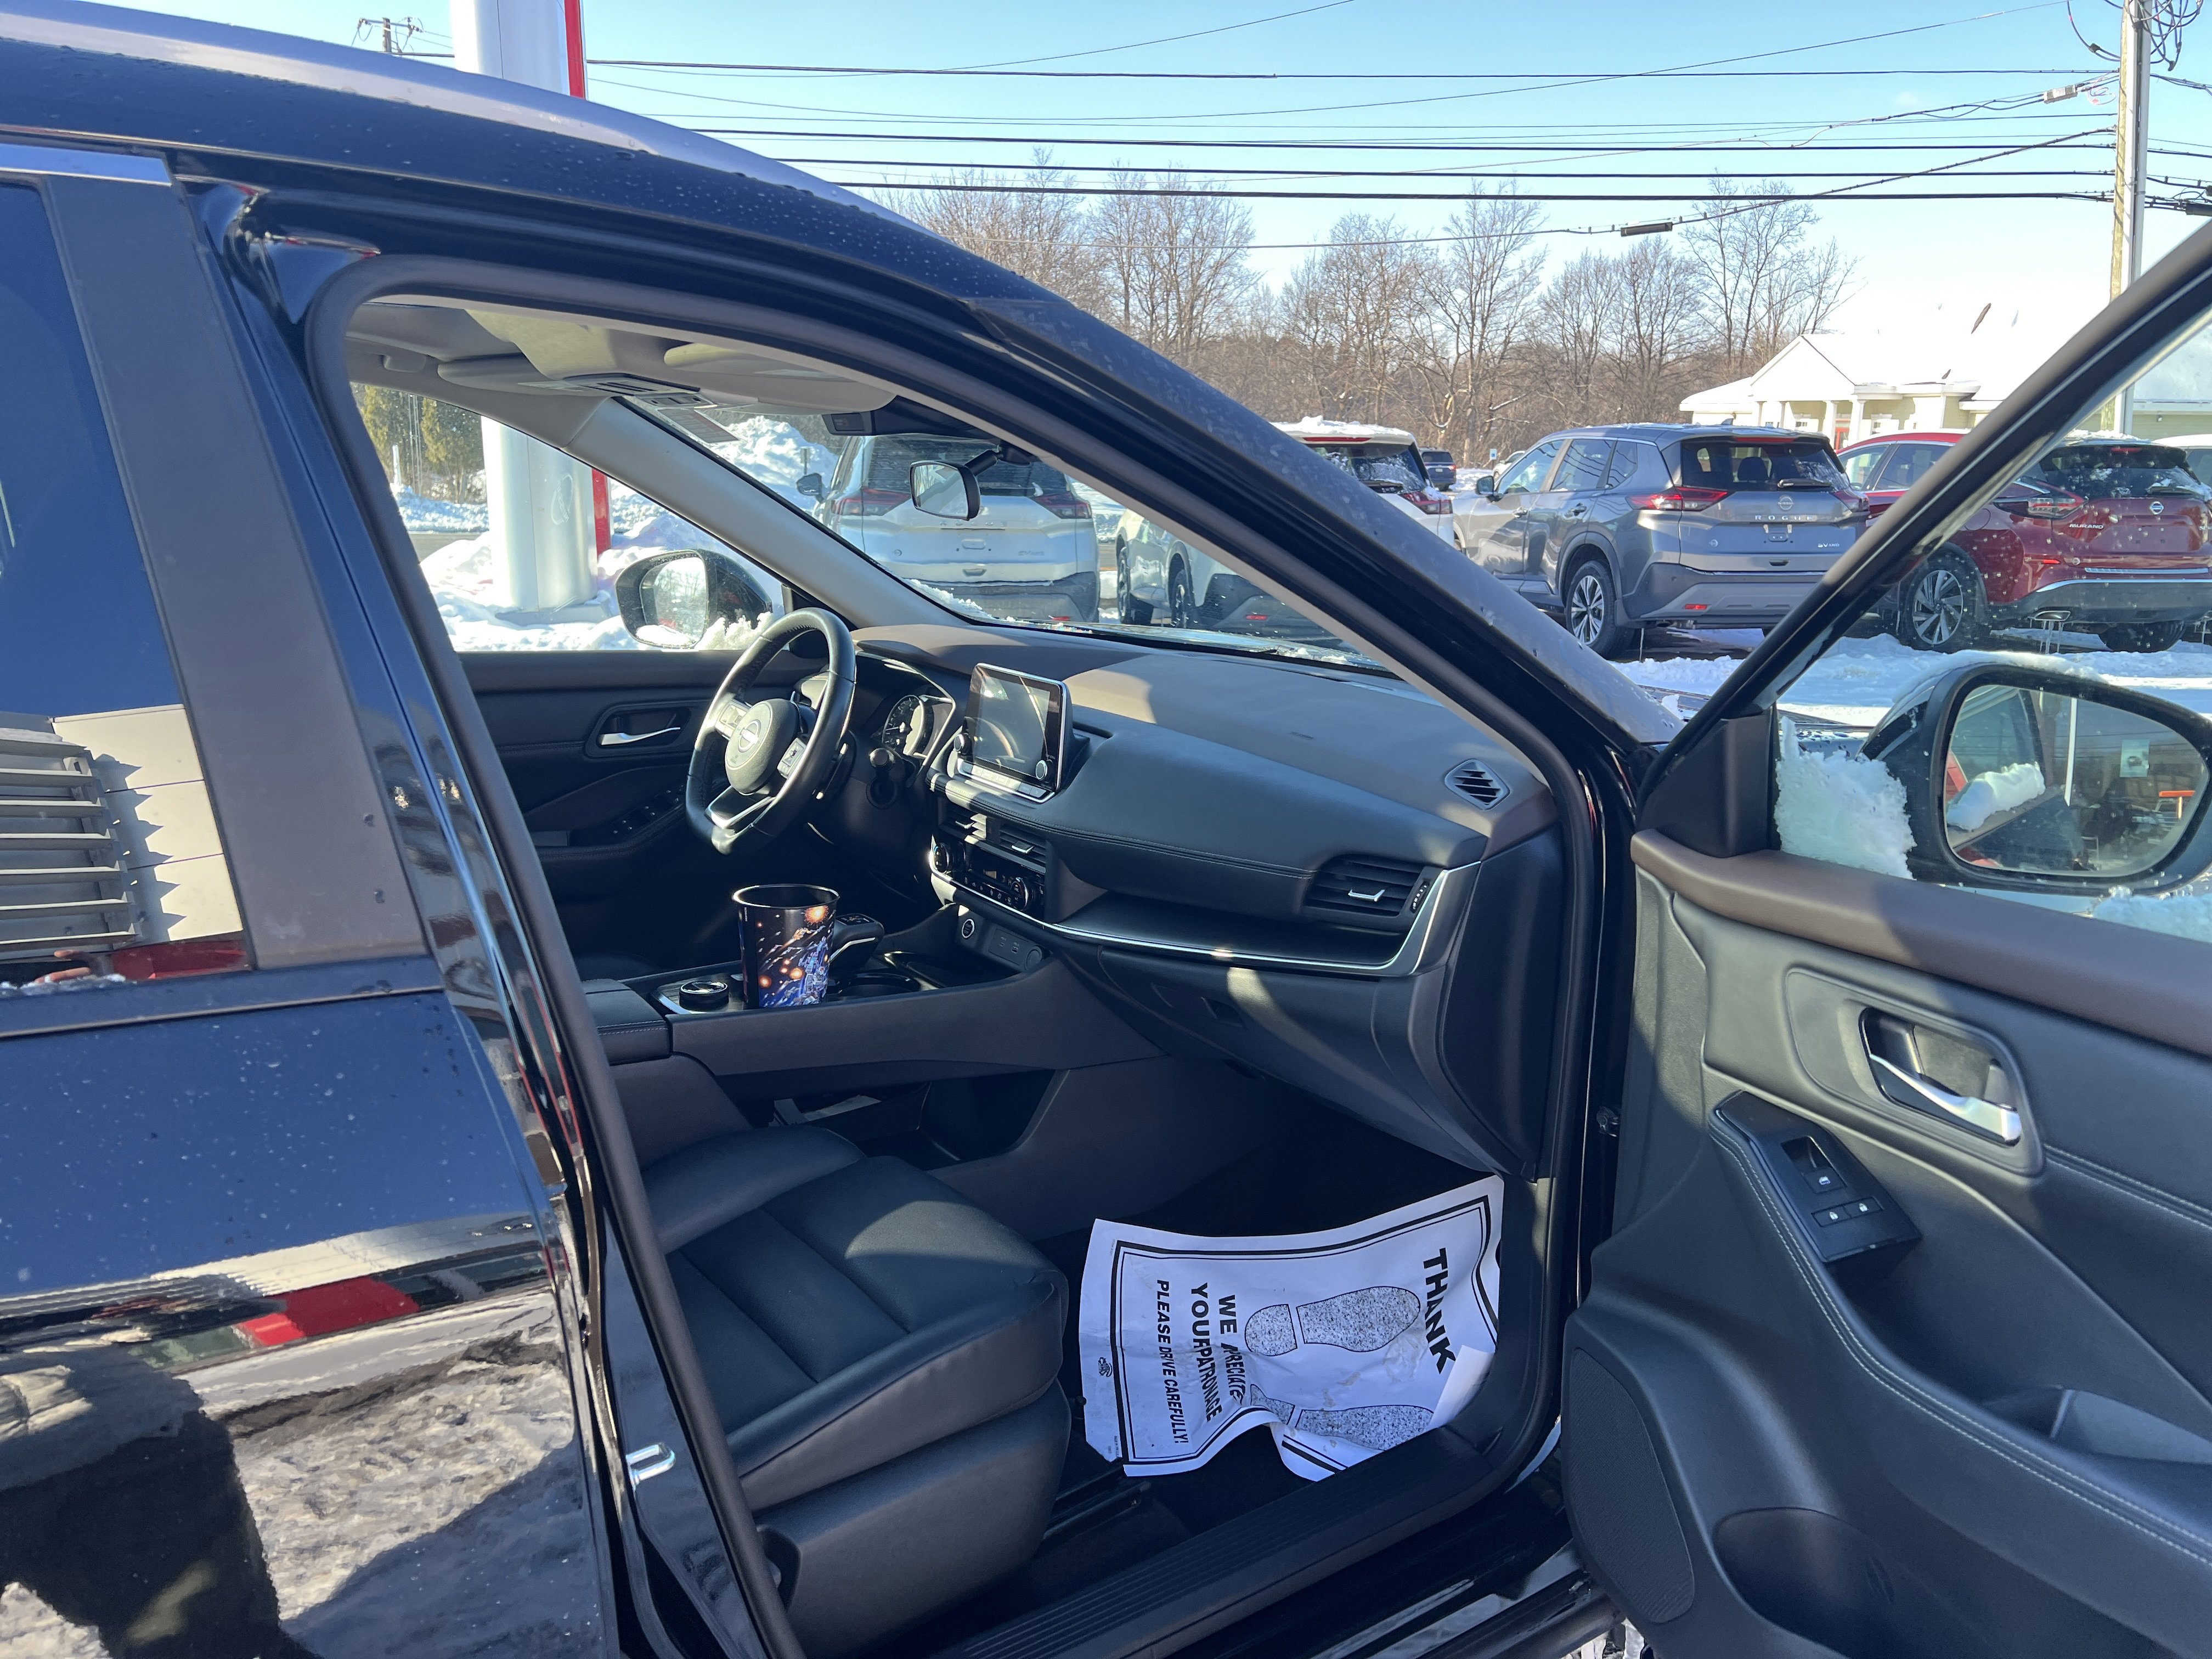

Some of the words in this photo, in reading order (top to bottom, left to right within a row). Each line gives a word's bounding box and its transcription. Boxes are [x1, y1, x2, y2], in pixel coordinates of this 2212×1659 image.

[1157, 1279, 1171, 1344] PLEASE
[1218, 1294, 1238, 1335] WE
[1423, 1247, 1456, 1375] THANK
[1159, 1346, 1177, 1378] DRIVE
[1196, 1346, 1223, 1422] PATRONAGE
[1164, 1379, 1189, 1444] CAREFULLY!
